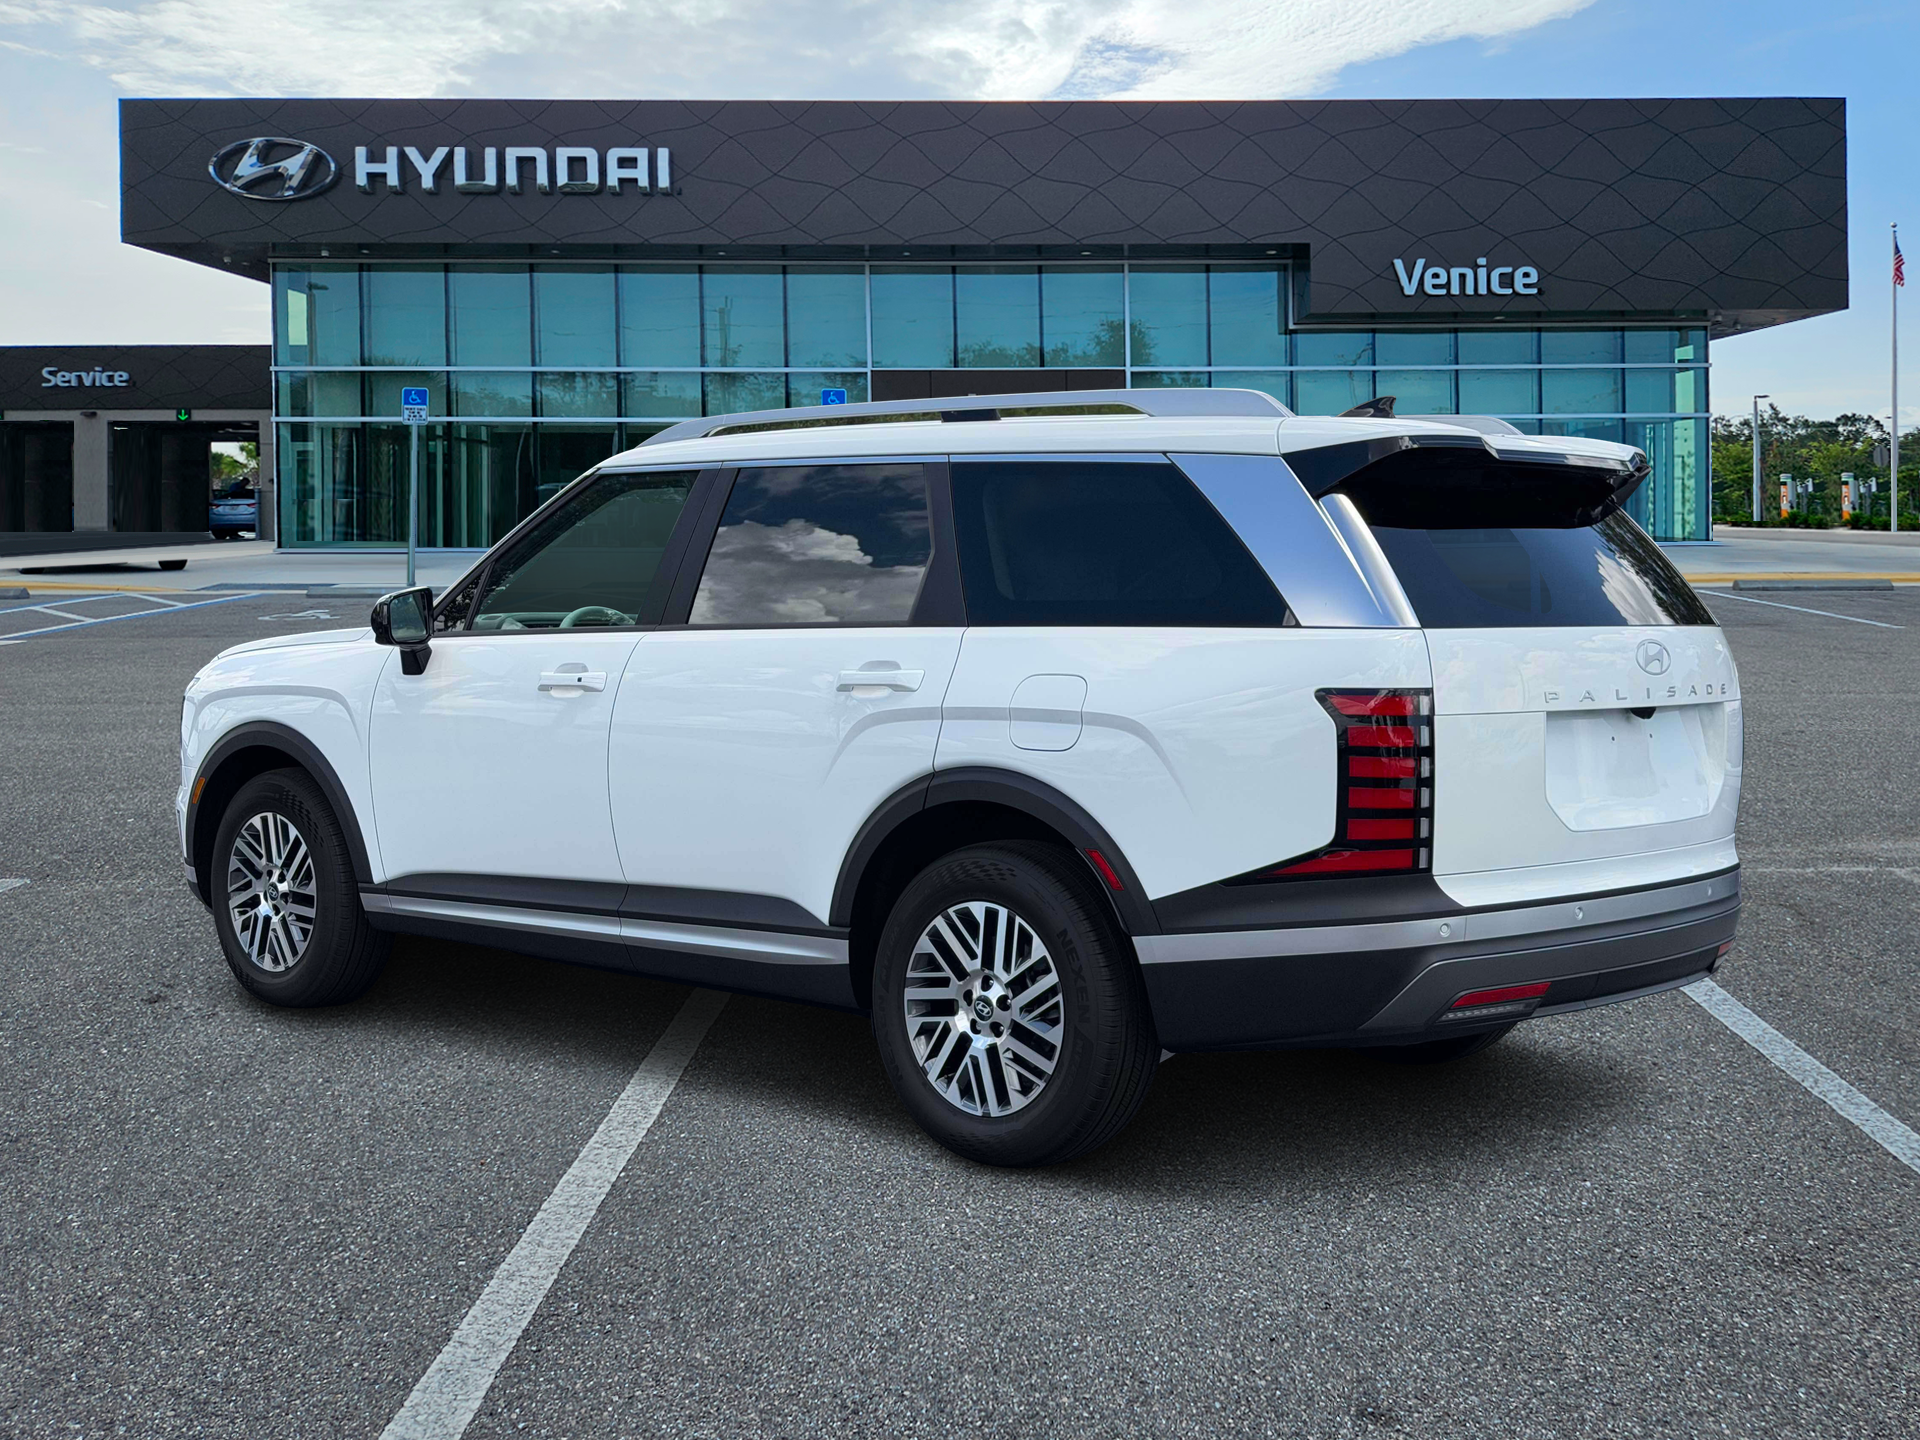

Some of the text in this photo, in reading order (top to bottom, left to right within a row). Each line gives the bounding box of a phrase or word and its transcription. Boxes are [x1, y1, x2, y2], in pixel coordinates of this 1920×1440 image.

[355, 146, 671, 193] HYUNDAI
[1393, 257, 1539, 296] Venice
[41, 366, 130, 387] Service
[1543, 683, 1727, 704] PALISADE
[1056, 927, 1091, 1024] NEXEN
